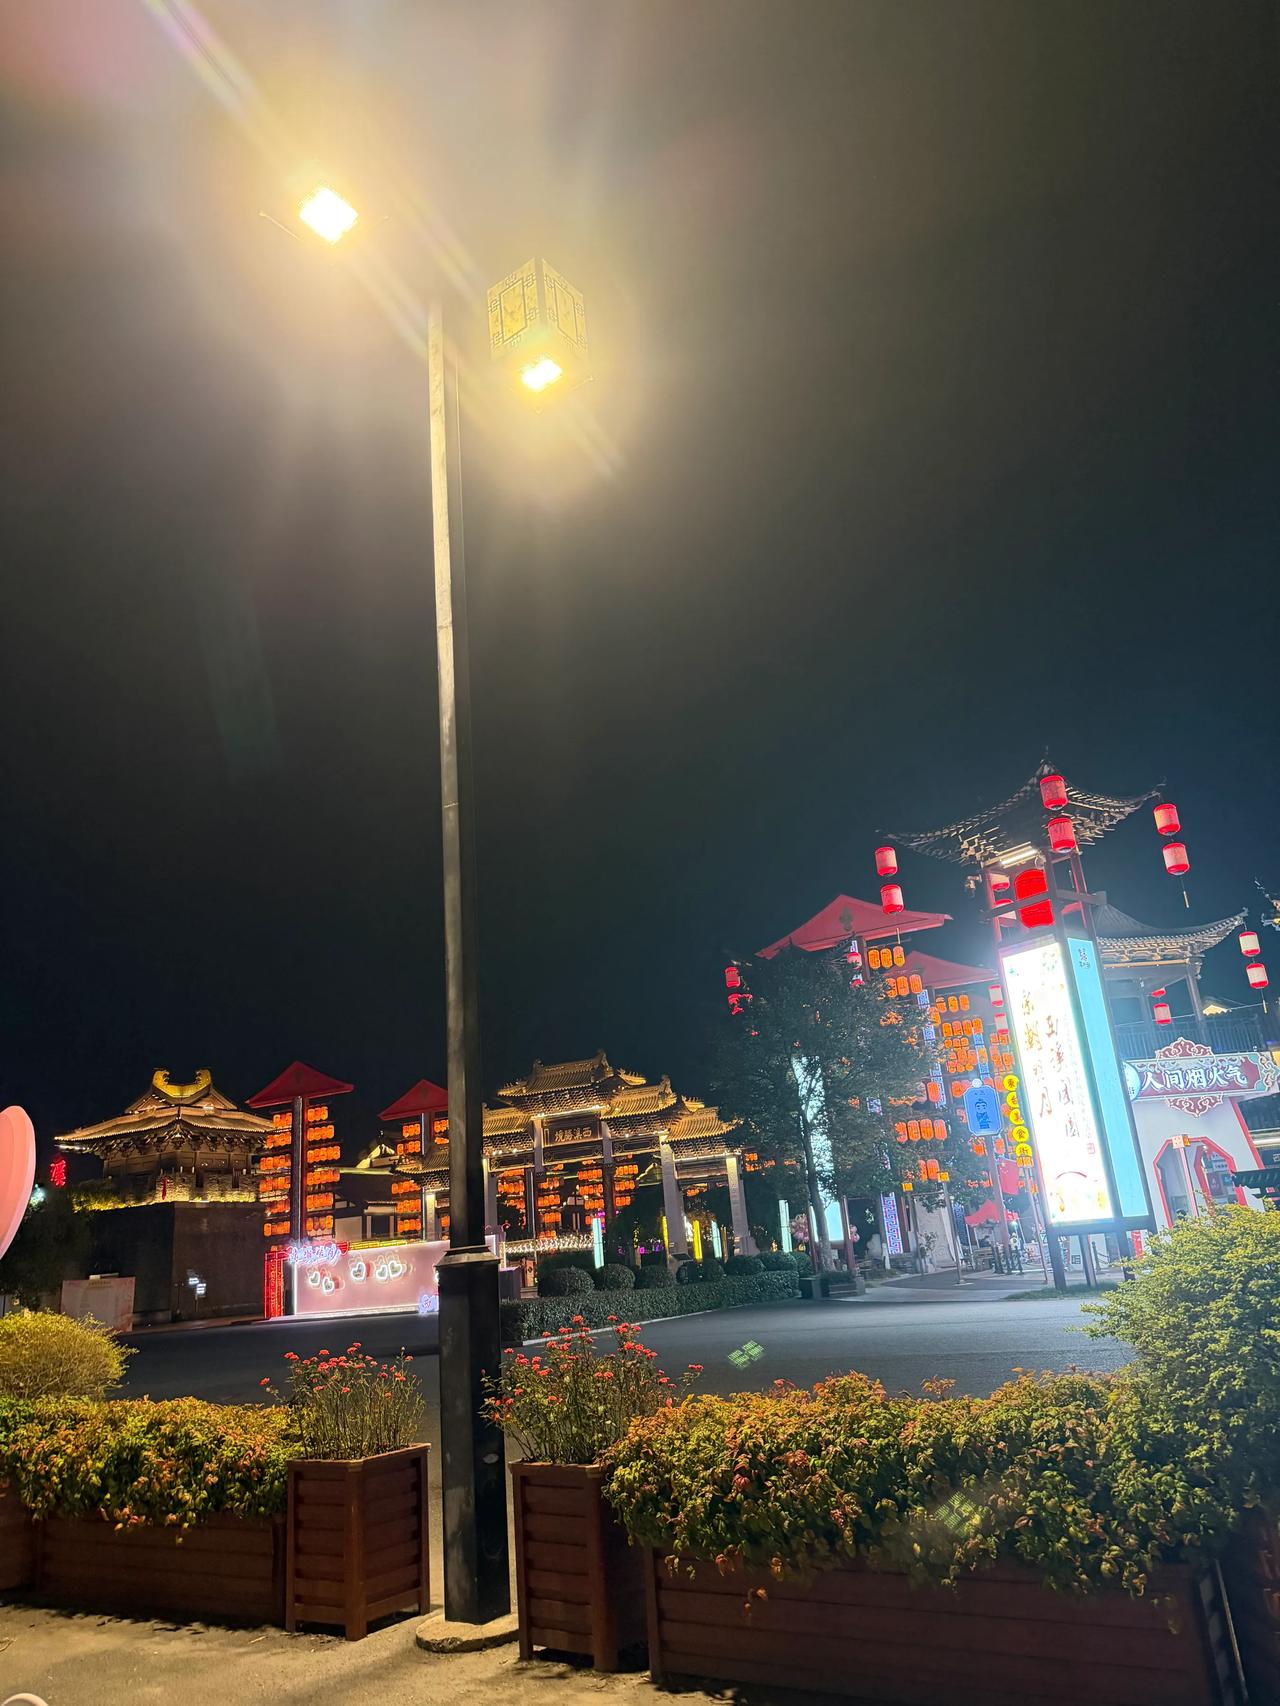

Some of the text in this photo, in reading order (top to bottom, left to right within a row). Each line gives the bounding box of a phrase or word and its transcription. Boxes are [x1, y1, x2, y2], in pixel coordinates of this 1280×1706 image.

[1142, 1065, 1248, 1091] 人间烟火气
